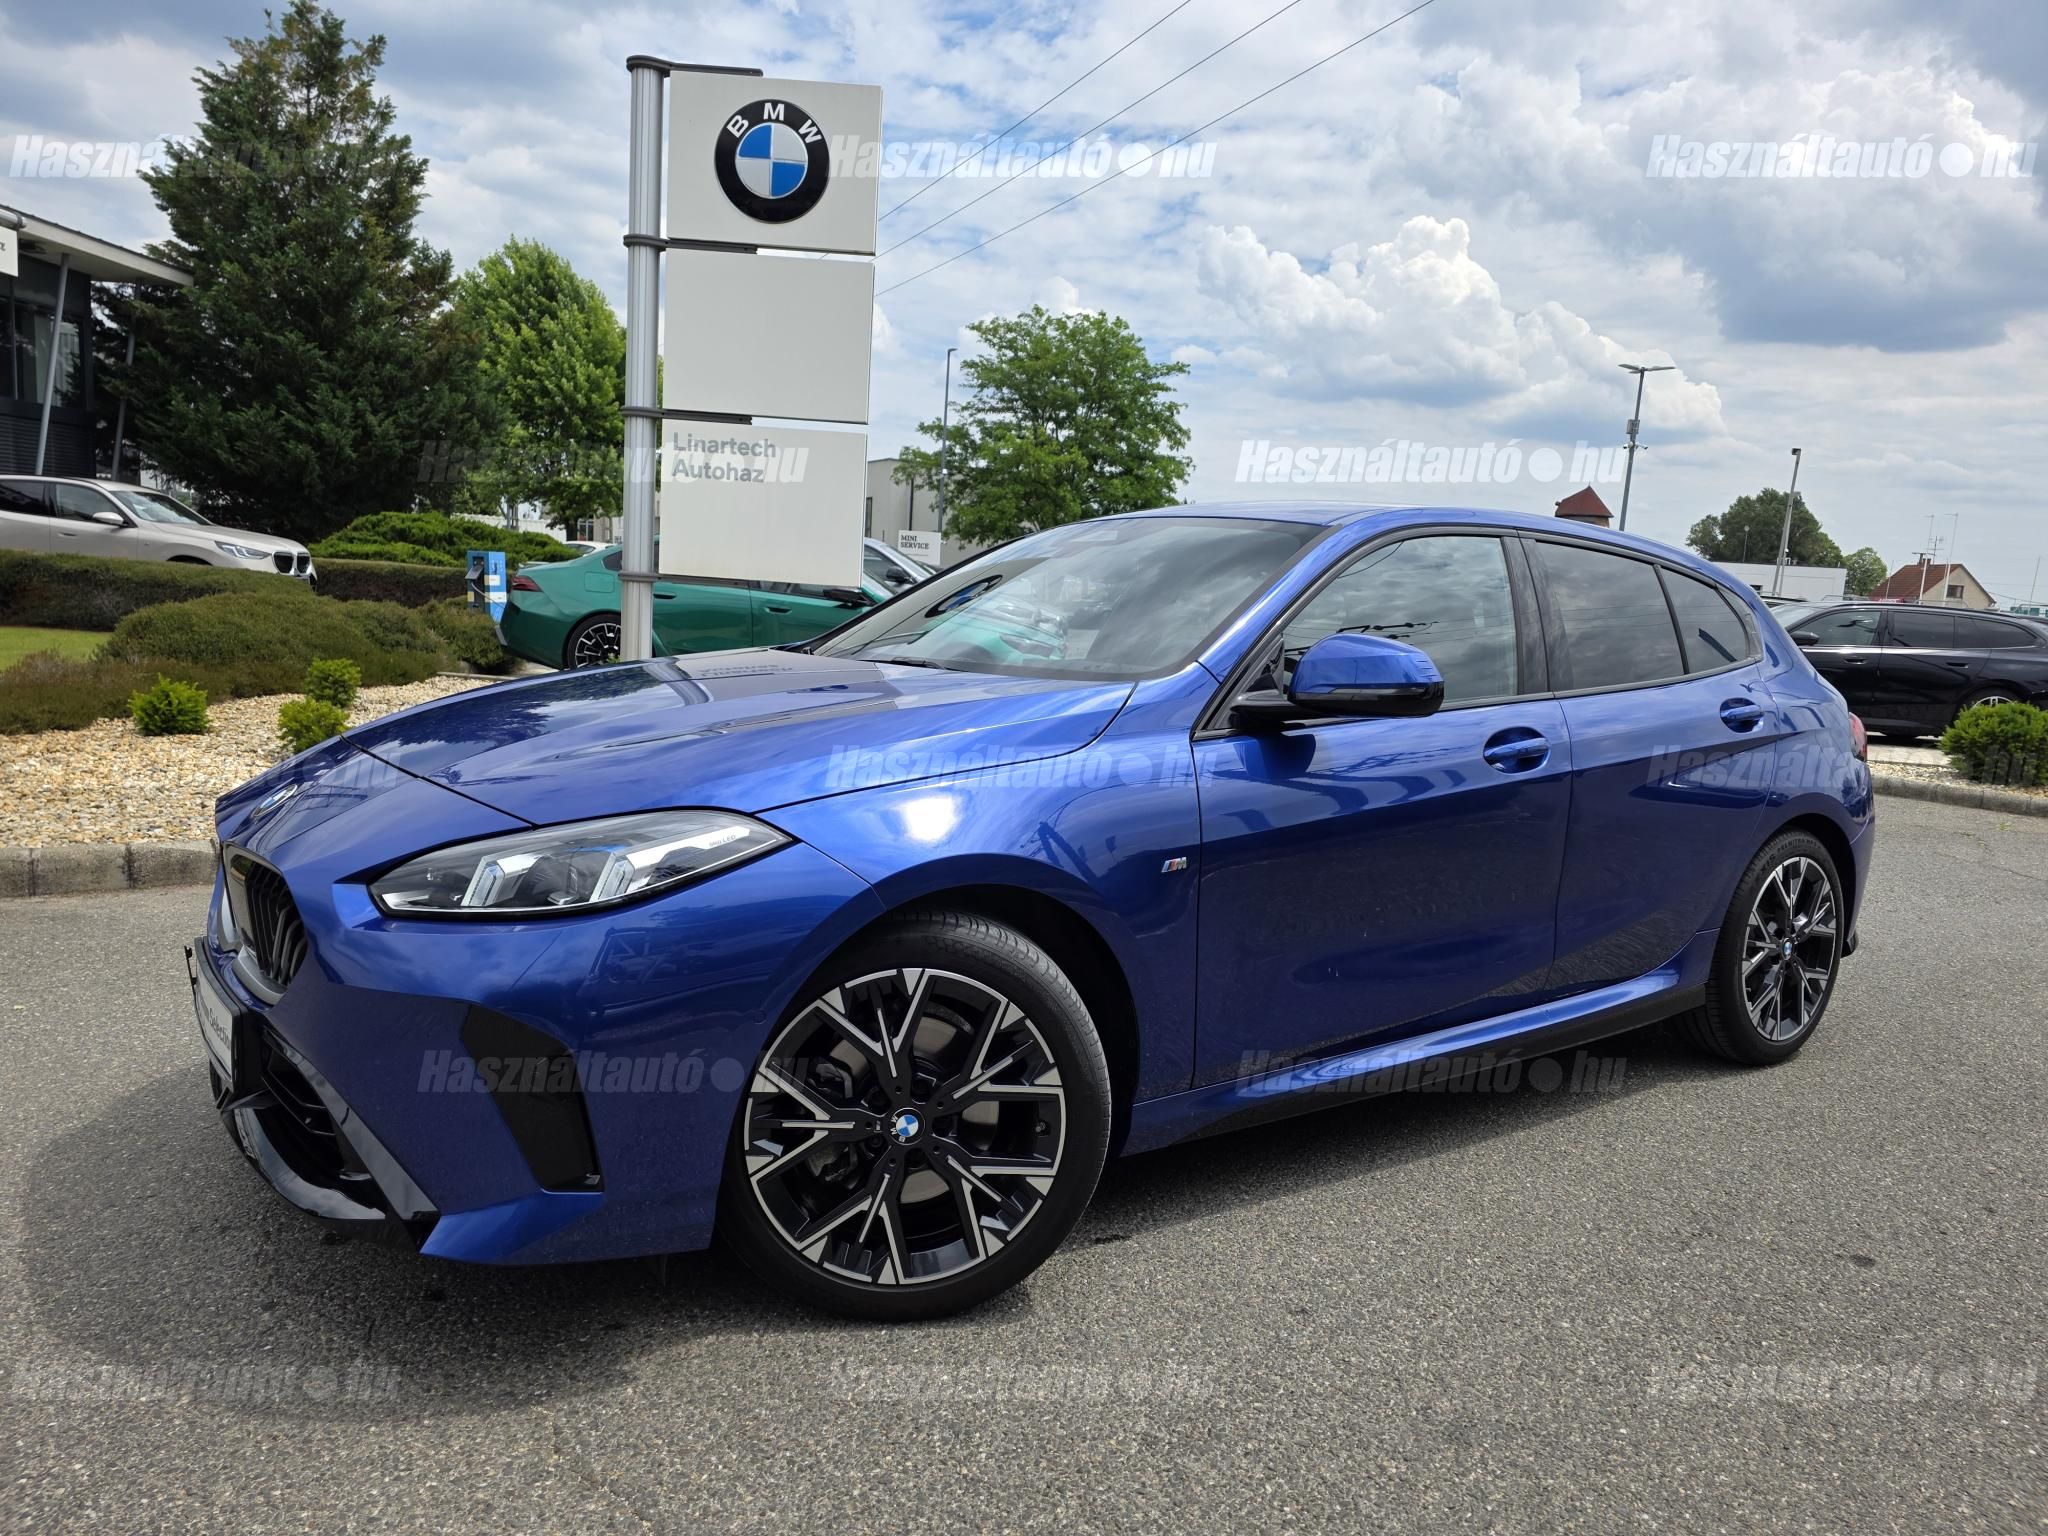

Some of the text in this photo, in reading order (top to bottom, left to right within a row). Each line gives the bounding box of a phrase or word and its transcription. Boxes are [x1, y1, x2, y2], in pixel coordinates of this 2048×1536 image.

[726, 102, 822, 144] BMW
[673, 431, 777, 458] Linartech
[672, 458, 765, 484] Autohaz
[900, 534, 917, 542] MINI
[900, 541, 930, 550] SERVICE
